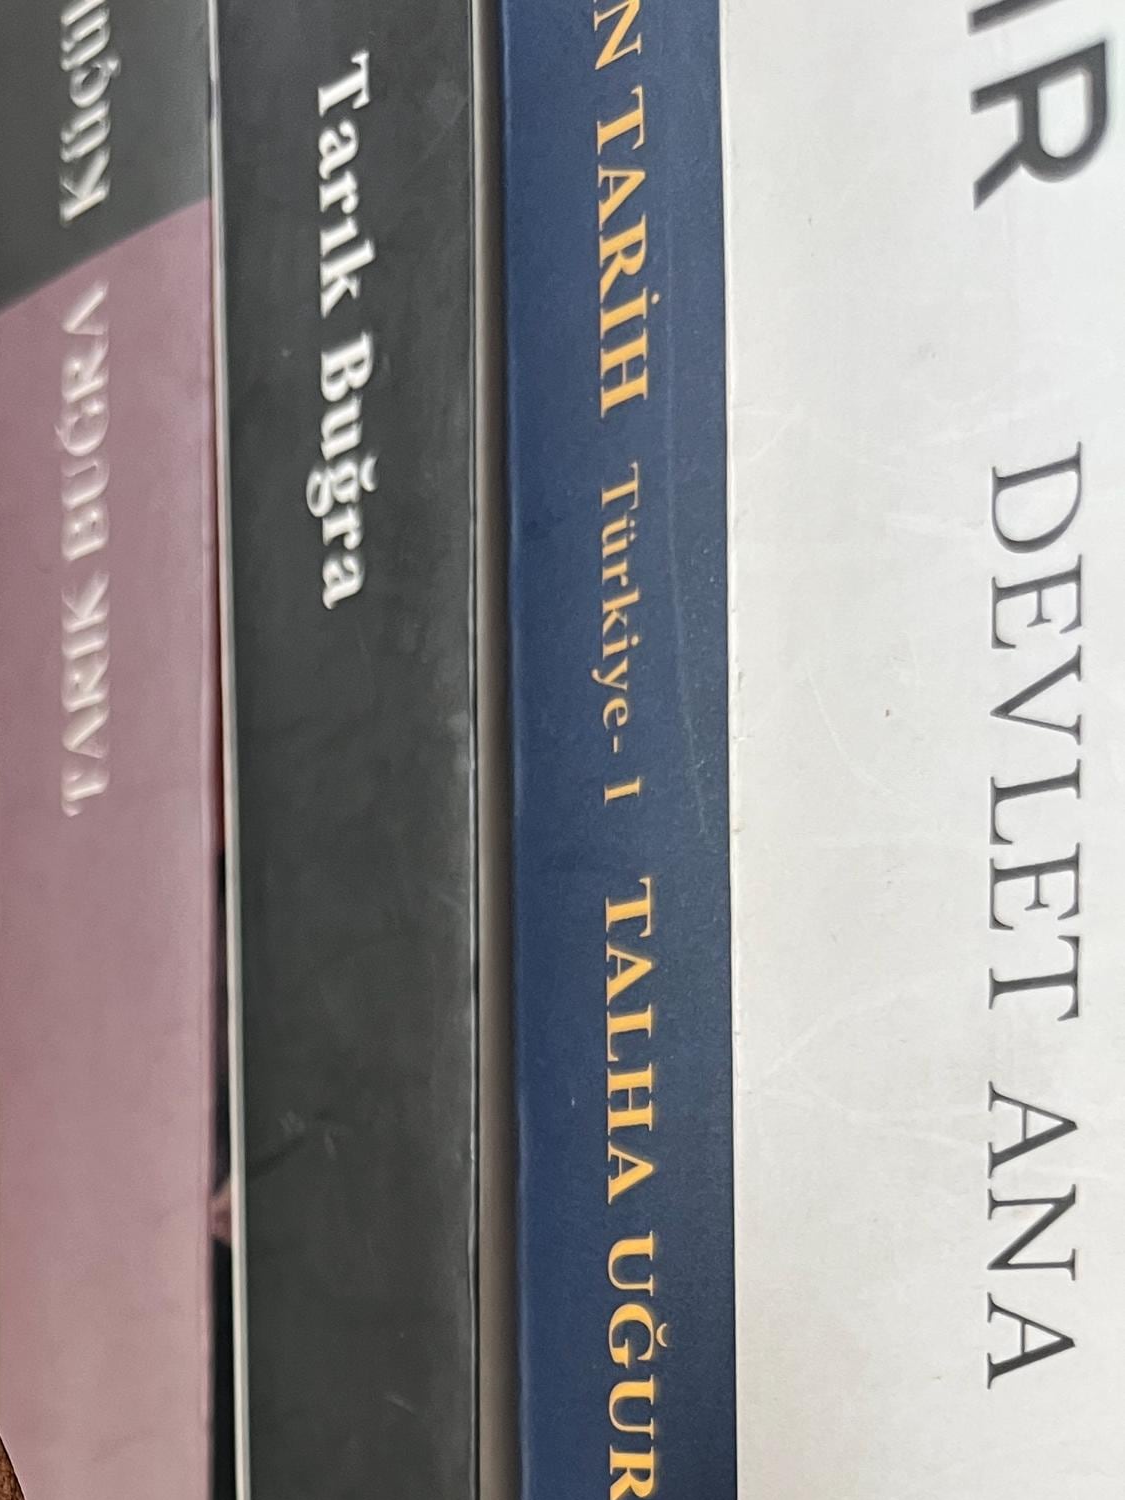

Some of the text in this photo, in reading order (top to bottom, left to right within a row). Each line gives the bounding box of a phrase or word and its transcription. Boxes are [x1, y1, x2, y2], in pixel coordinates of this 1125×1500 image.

[59, 0, 121, 227] Küçü
[597, 85, 660, 419] TARİH
[305, 48, 378, 610] Tarık Buğra
[988, 440, 1083, 1021] DEVLET
[605, 876, 655, 1206] TALHA
[987, 1081, 1079, 1390] ANA
